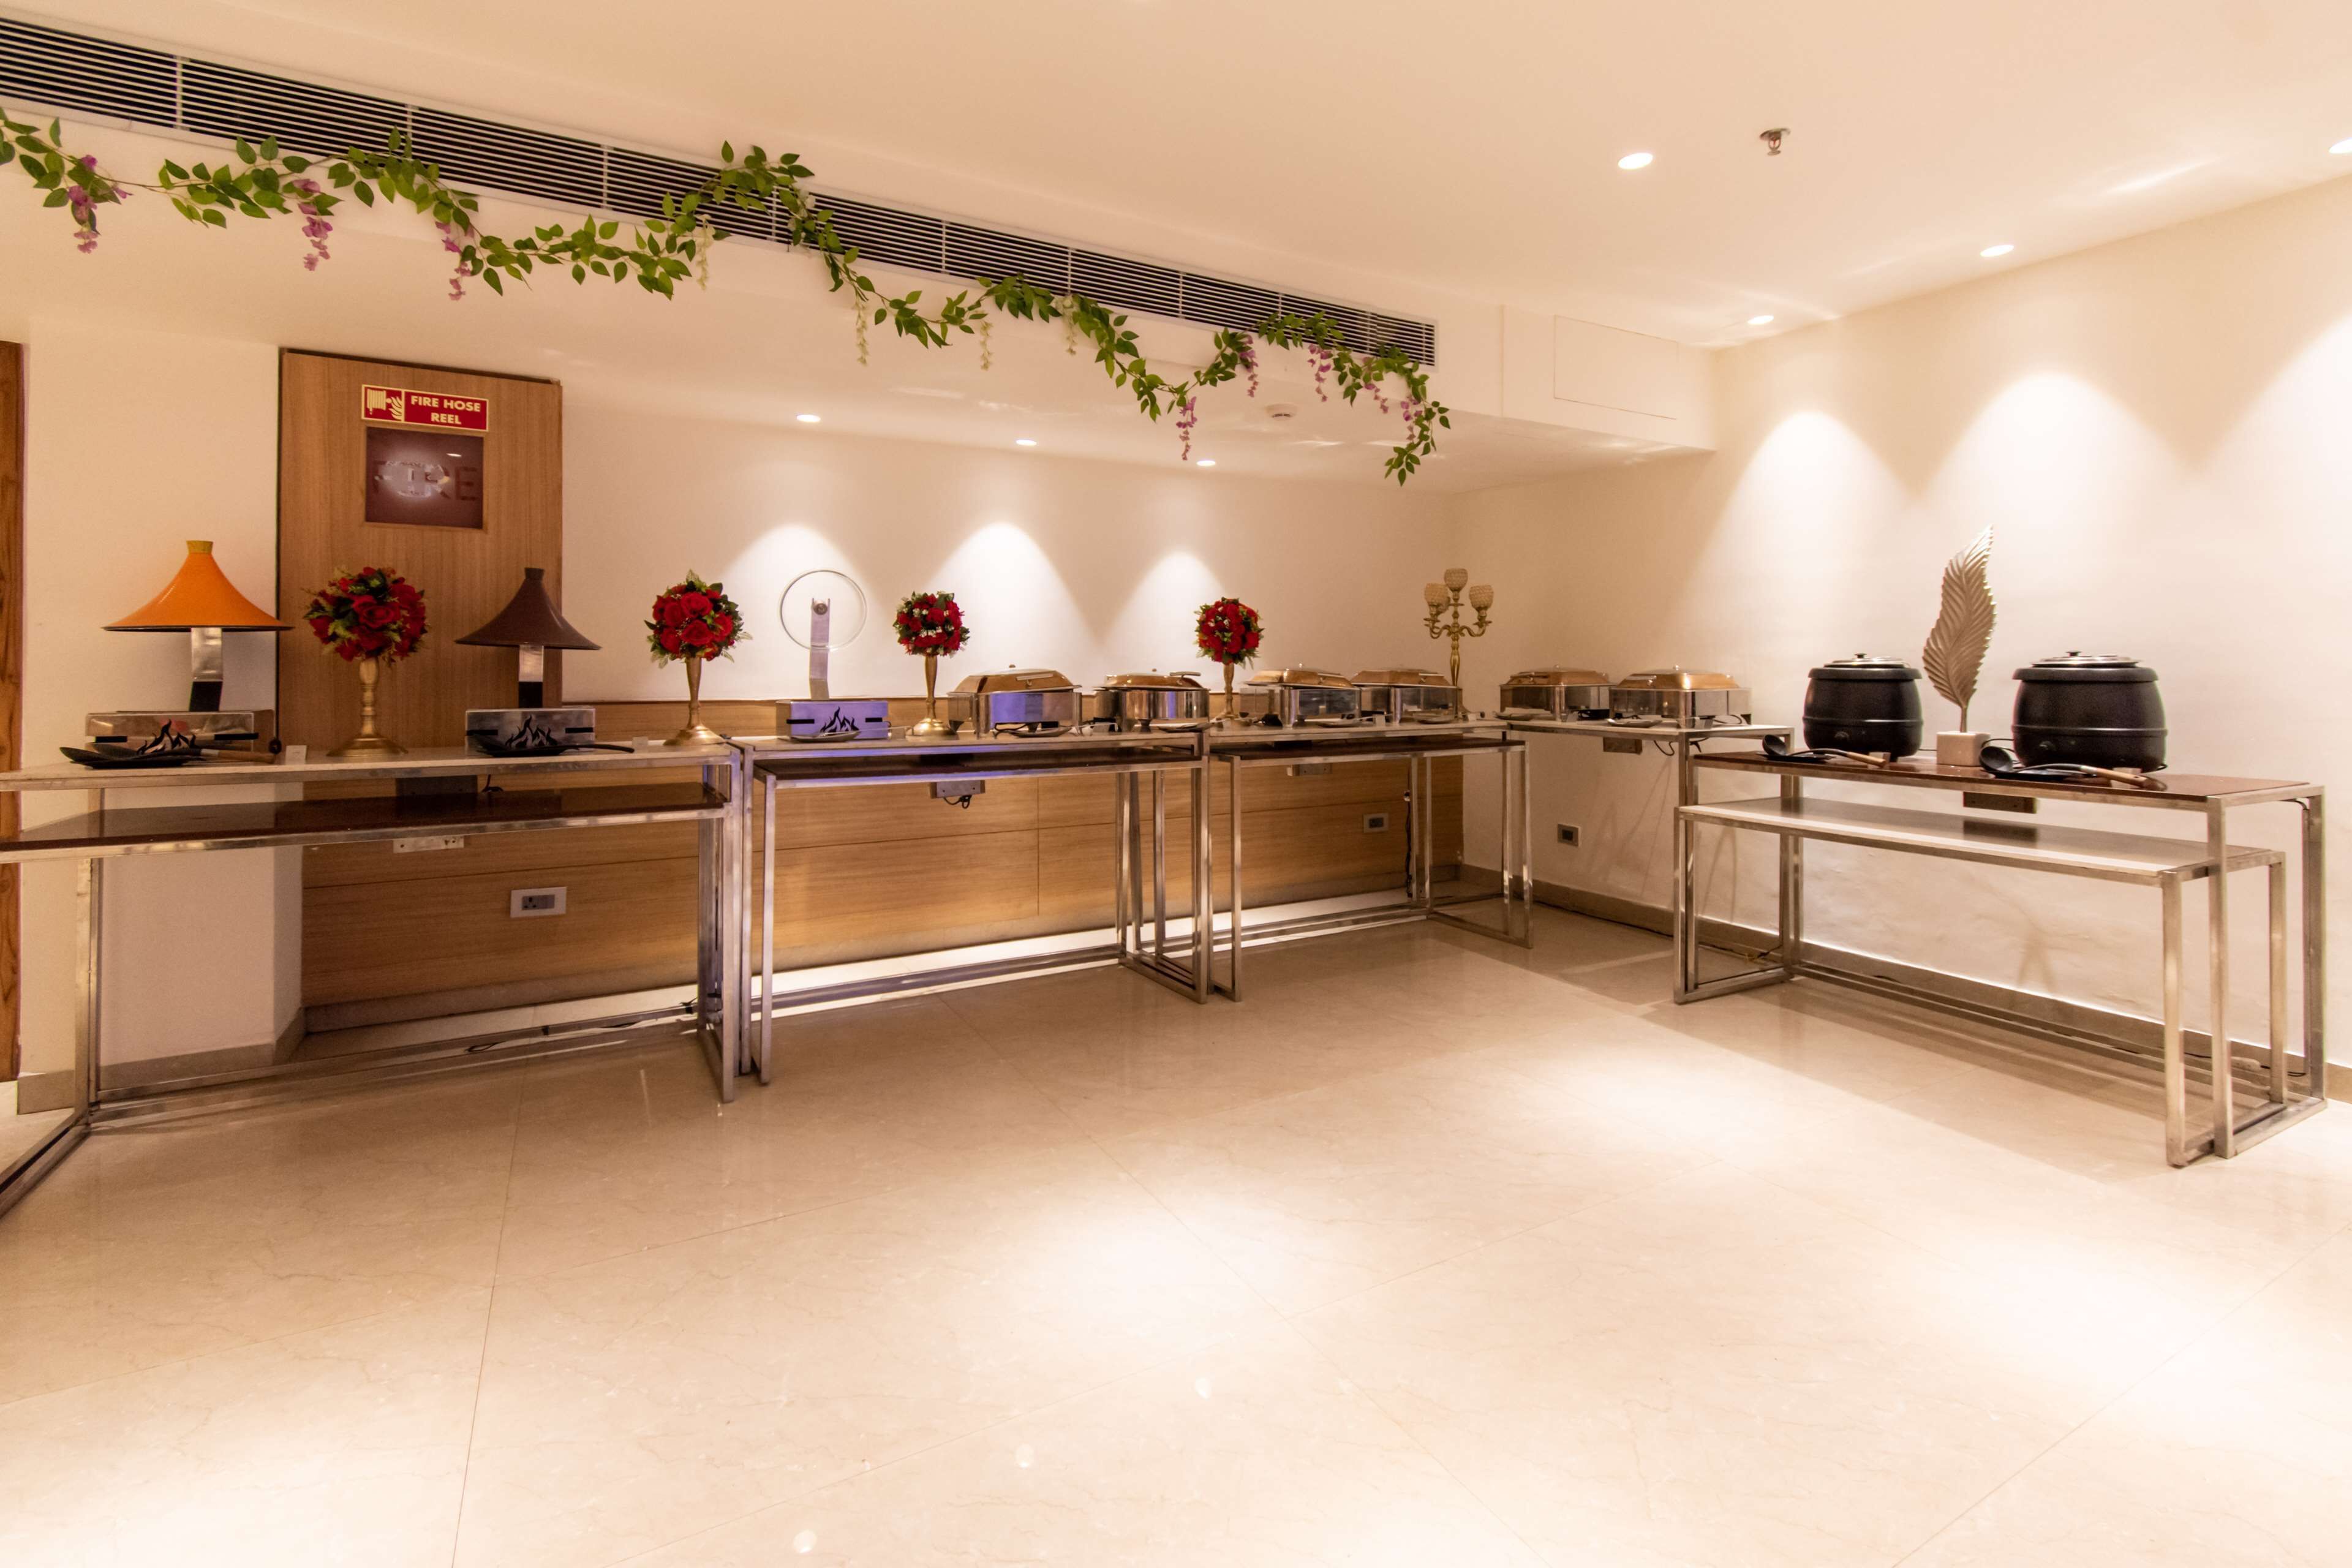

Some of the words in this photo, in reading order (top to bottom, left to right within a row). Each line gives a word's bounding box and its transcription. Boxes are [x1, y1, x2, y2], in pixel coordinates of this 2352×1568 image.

[411, 395, 439, 407] FIRE
[443, 399, 481, 412] HOSE
[431, 412, 461, 424] REEL
